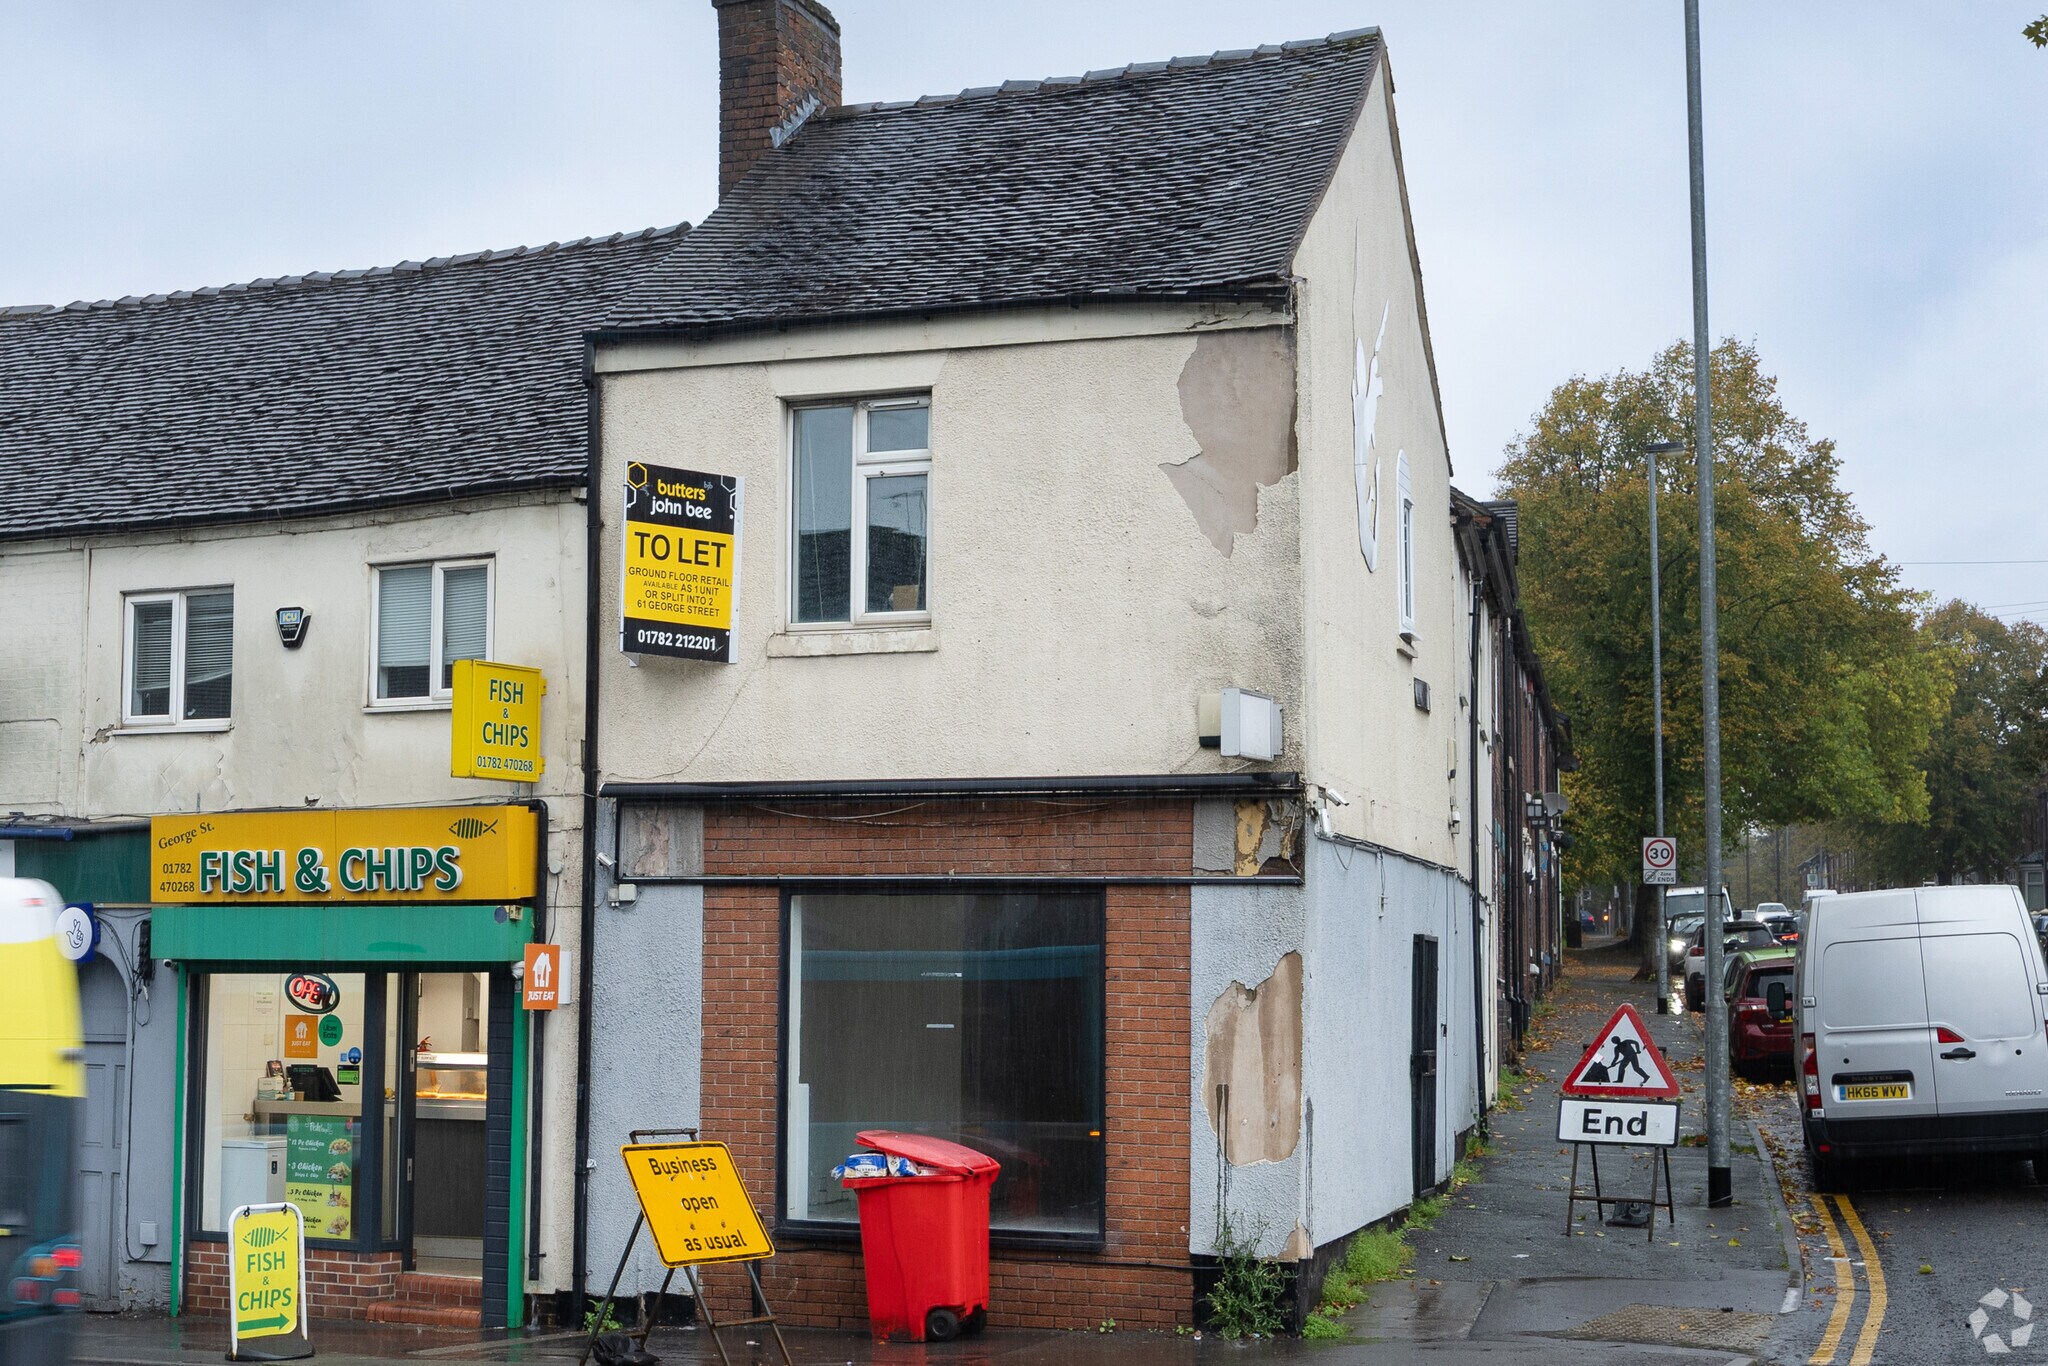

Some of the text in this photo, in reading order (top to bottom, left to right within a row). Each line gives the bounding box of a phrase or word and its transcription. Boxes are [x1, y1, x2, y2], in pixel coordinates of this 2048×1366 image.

[657, 478, 706, 501] butters
[650, 495, 713, 520] john bee
[634, 531, 727, 568] TO LET
[628, 566, 730, 588] GROUND FLOOR RETAIL
[643, 580, 719, 597] AVAILABLE AS 1 UNIT
[645, 589, 714, 606] OR SPLIT INTO 2
[282, 611, 298, 623] ICU
[636, 599, 720, 617] 61 GEORGE STREET
[637, 629, 716, 651] 01782 212201
[489, 678, 524, 705] FISH
[502, 707, 509, 719] &
[482, 721, 529, 748] CHIPS
[477, 755, 534, 772] 01782 470268
[157, 821, 215, 850] George St.
[1650, 848, 1670, 859] 30
[162, 862, 192, 874] 01782
[200, 845, 464, 894] FISH & CHIPS
[159, 881, 195, 893] 470268
[291, 977, 333, 1008] OPEN
[527, 990, 556, 1002] JUST EAT
[1847, 1086, 1905, 1098] HK66 WVY
[2005, 1089, 2042, 1097] RENAULT
[1582, 1108, 1648, 1136] End
[648, 1156, 717, 1176] Business
[681, 1196, 719, 1214] open
[684, 1229, 747, 1252] as usual
[247, 1251, 286, 1273] FISH
[262, 1276, 269, 1286] &
[238, 1287, 292, 1311] CHIPS
